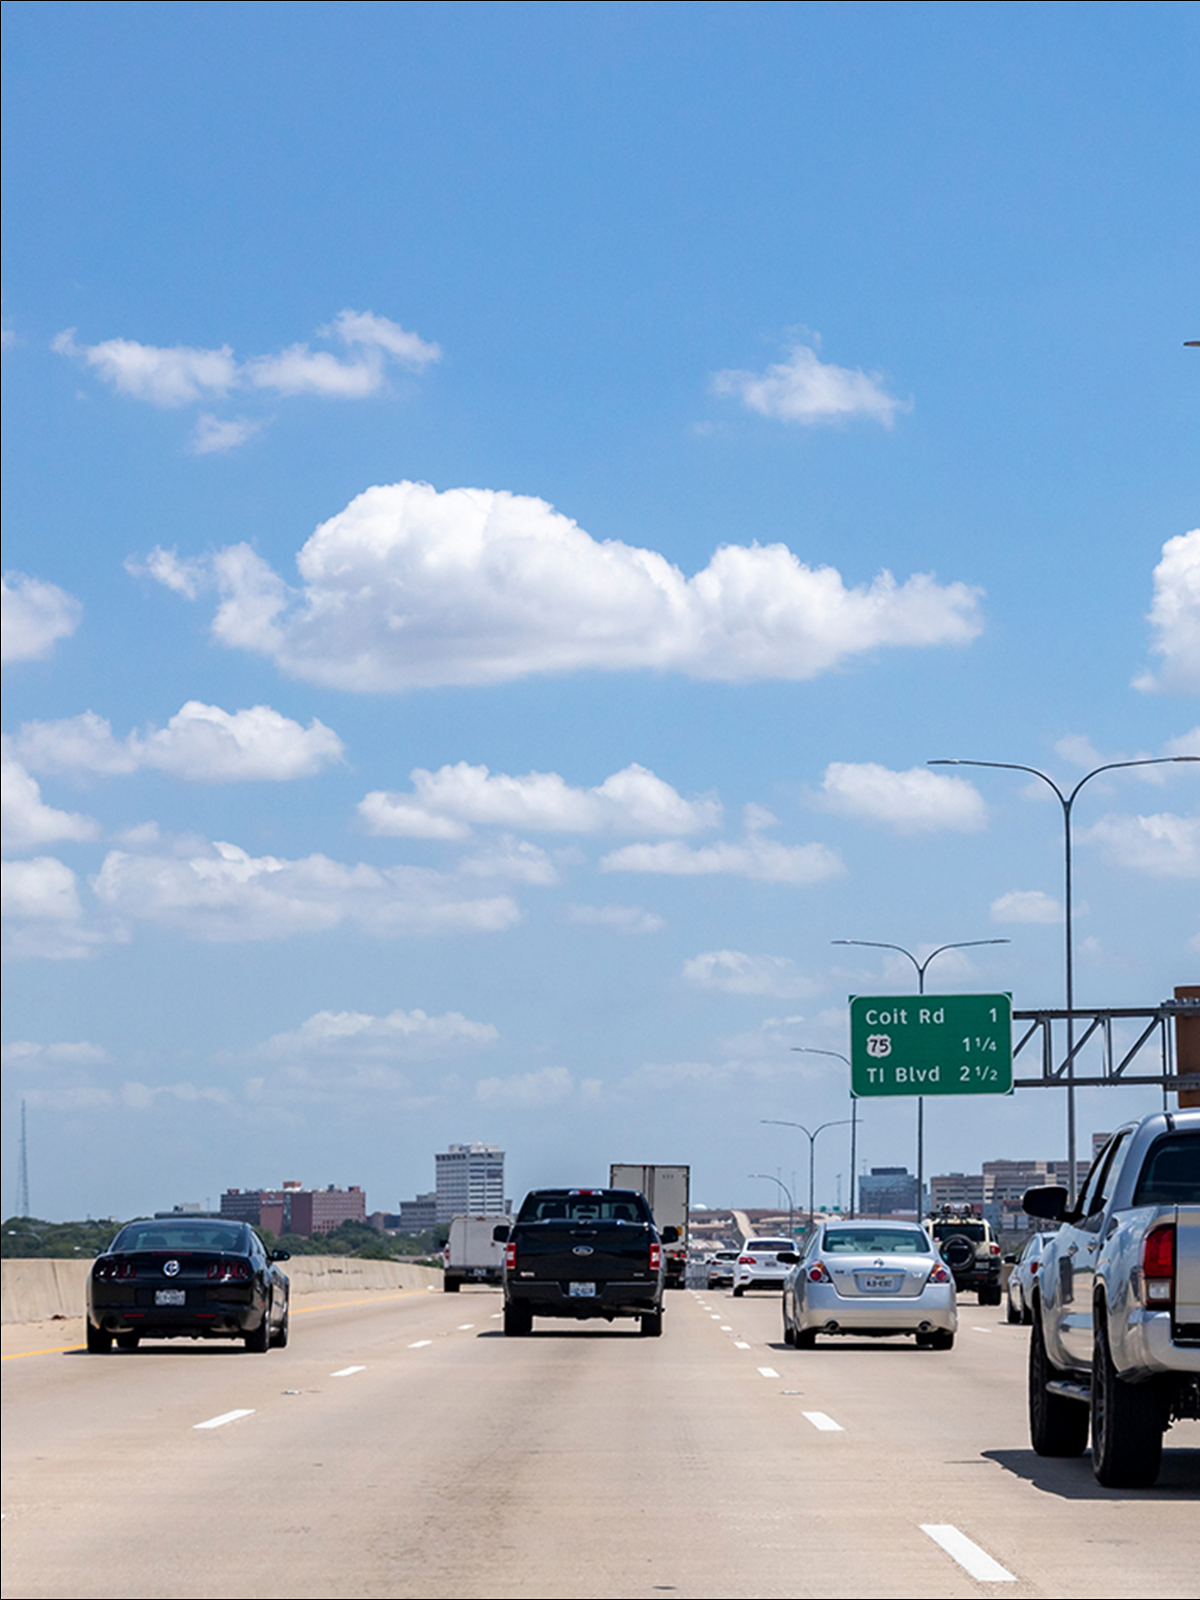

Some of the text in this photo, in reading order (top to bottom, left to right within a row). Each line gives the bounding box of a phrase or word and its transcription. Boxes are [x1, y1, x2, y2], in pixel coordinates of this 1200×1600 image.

[866, 1007, 997, 1025] Coit Rd 1
[869, 1038, 890, 1054] 75
[867, 1067, 885, 1083] TI
[895, 1066, 940, 1082] Blvd
